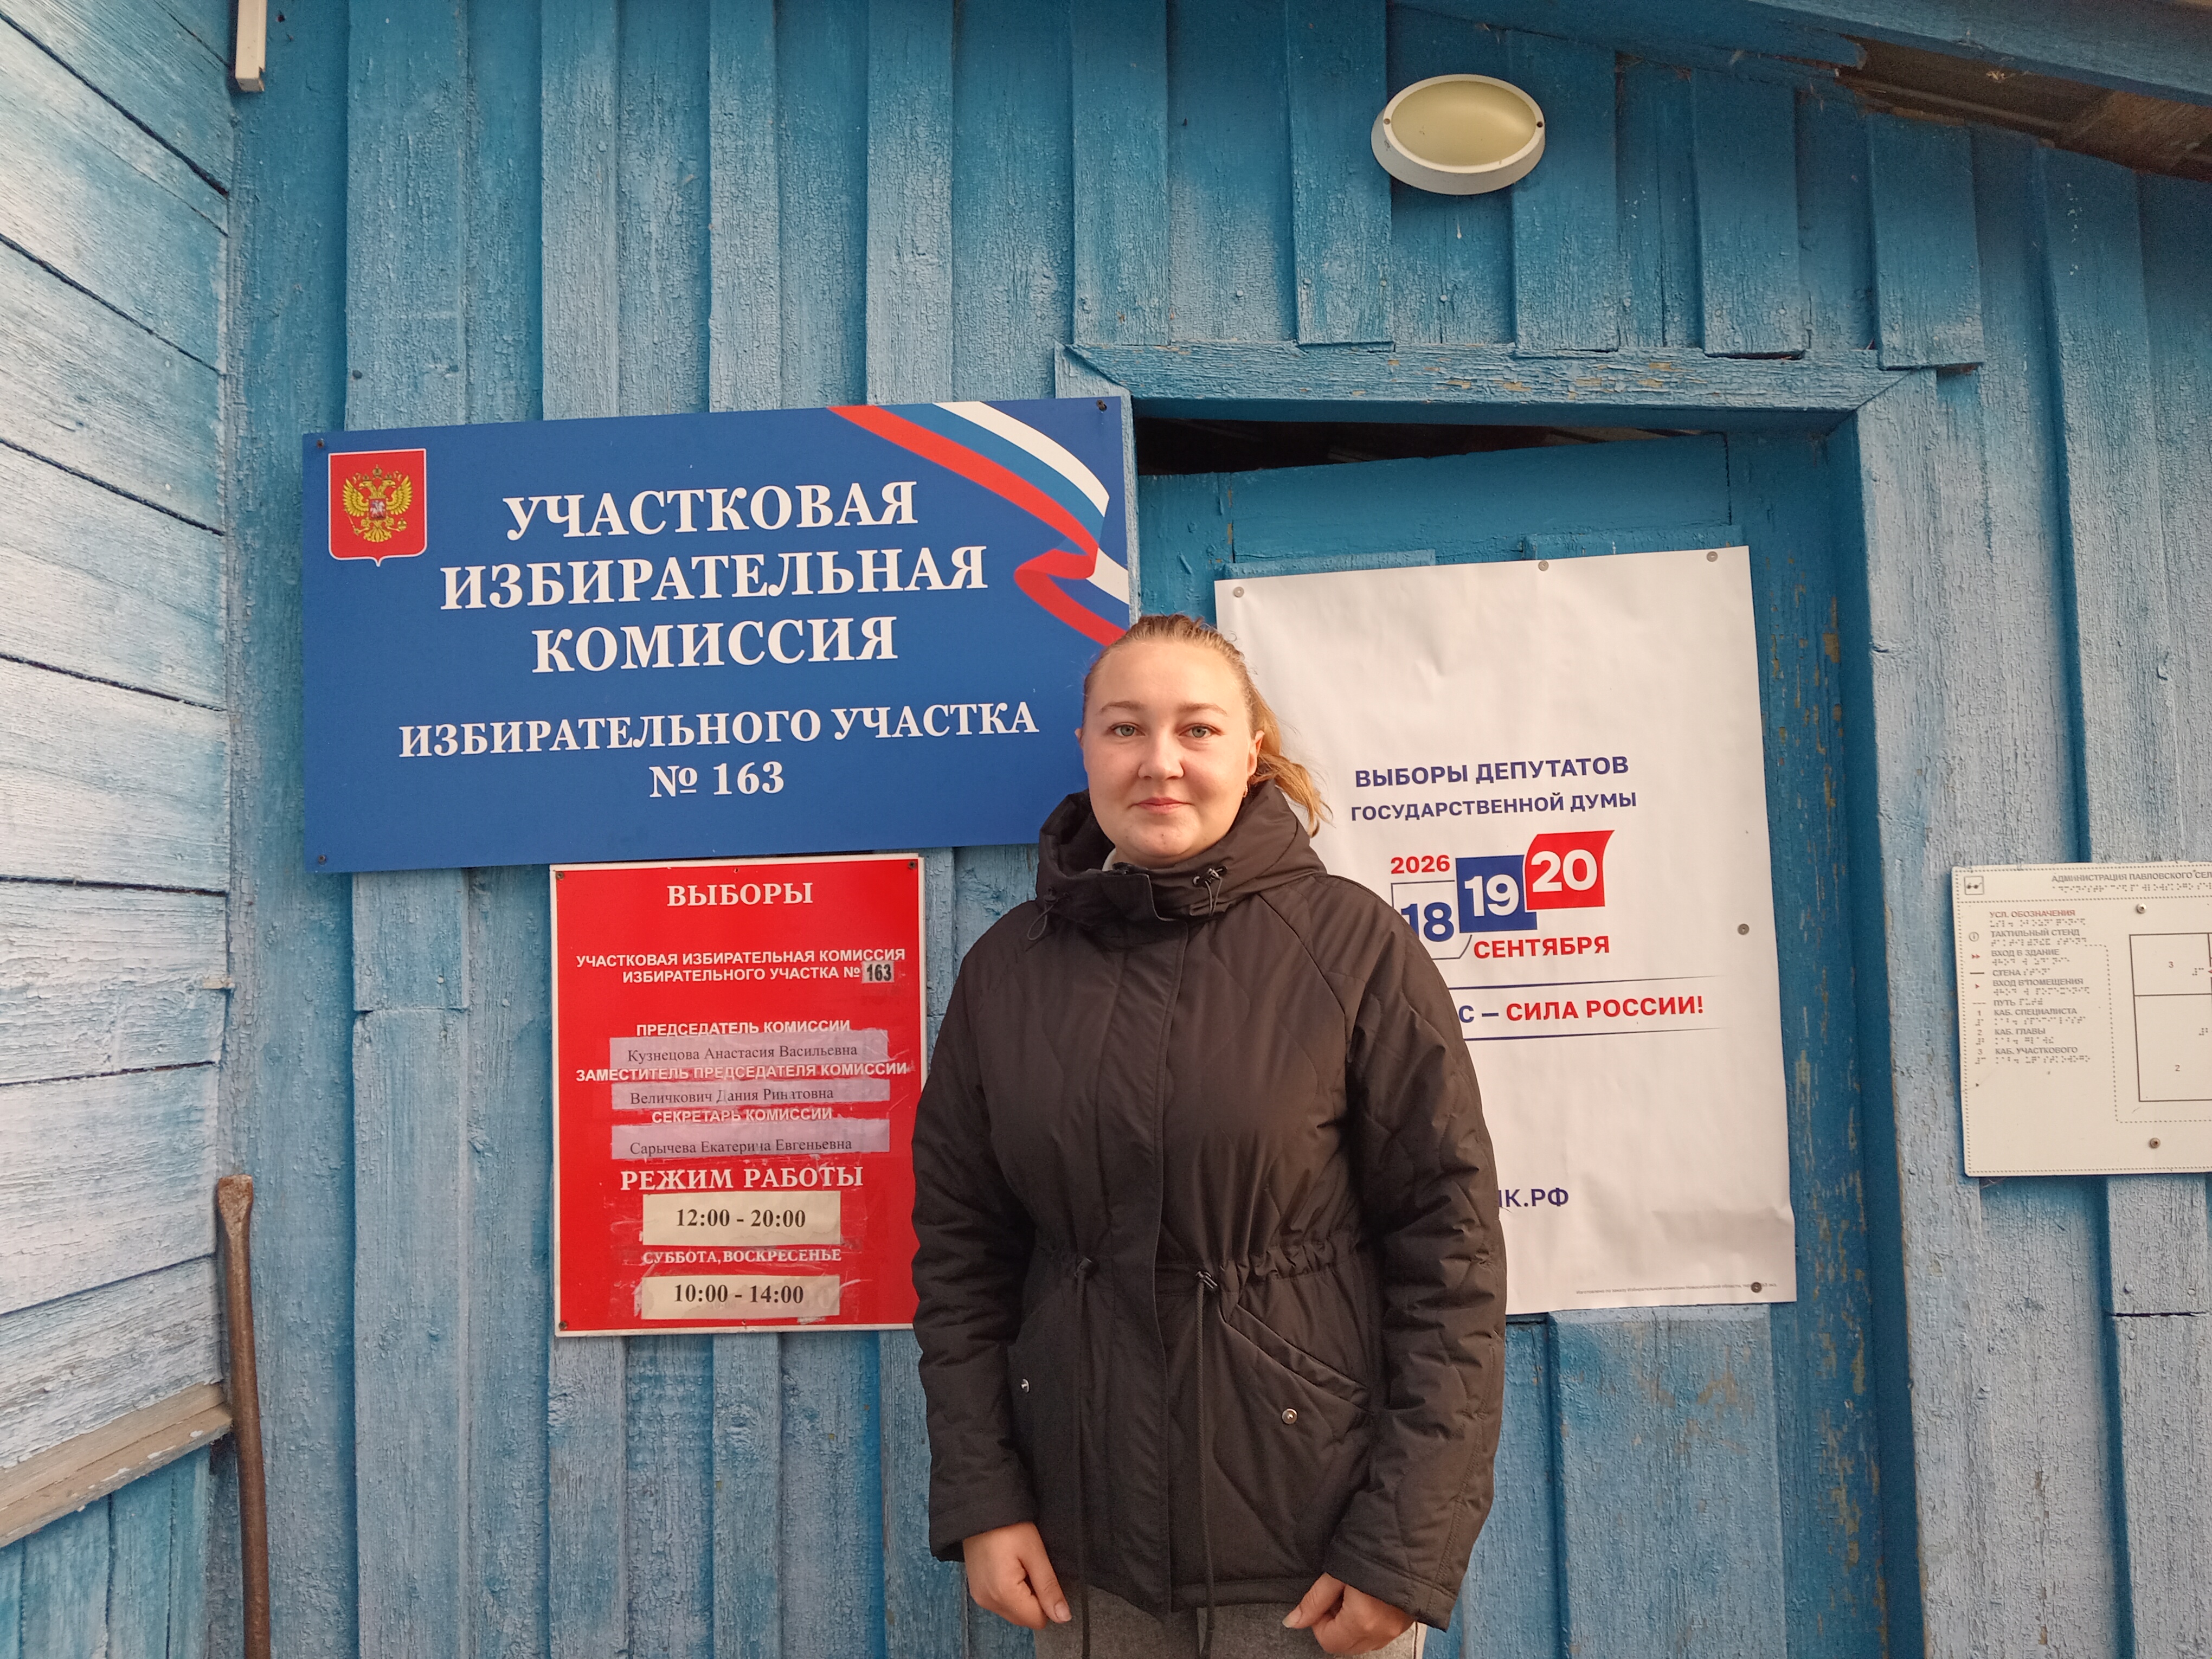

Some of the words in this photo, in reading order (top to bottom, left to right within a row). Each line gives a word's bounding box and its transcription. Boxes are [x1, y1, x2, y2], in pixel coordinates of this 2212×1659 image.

[503, 481, 918, 540] УЧАСТКОВАЯ
[440, 546, 988, 609] ИЗБИРАТЕЛЬНАЯ
[532, 617, 898, 672] КОМИССИЯ
[399, 710, 820, 757] ИЗБИРАТЕЛЬНОГО
[831, 702, 1039, 740] УЧАСТКА
[649, 766, 697, 797] №
[713, 762, 783, 795] 163
[1356, 765, 1468, 787] ВЫБОРЫ
[1476, 756, 1628, 784] ДЕПУТАТОВ
[1352, 796, 1564, 821] ГОСУДАРСТВЕННОЙ
[1571, 793, 1636, 812] ДУМЫ
[1391, 855, 1450, 874] 2026
[2052, 874, 2127, 883] АДМИНИСТРАЦИЯ
[2129, 872, 2192, 880] ПАВЛОВСКОГО
[667, 883, 813, 906] ВЫБОРЫ
[1401, 902, 1454, 942] 18
[1465, 874, 1519, 916] 19
[1532, 850, 1597, 892] 20
[1991, 928, 2049, 937] ТАКТИЛЬНЫЙ
[1474, 936, 1609, 959] СЕНТЯБРЯ
[576, 954, 677, 967] УЧАСТКОВАЯ
[683, 950, 814, 964] ИЗБИРАТЕЛЬНАЯ
[820, 949, 904, 962] КОМИССИЯ
[623, 968, 765, 983] ИЗБИРАТЕЛЬНОГО
[770, 967, 839, 979] УЧАСТКА
[844, 967, 860, 978] №
[866, 963, 892, 982] 163
[1507, 1001, 1578, 1021] СИЛА
[1586, 996, 1702, 1018] РОССИИ!
[2015, 1008, 2077, 1016] СПЕЦИАЛИСТА
[636, 1023, 759, 1037] ПРЕДСЕДАТЕЛЬ
[763, 1019, 850, 1033] КОМИССИИ
[628, 1049, 700, 1063] Кузнецова
[704, 1047, 775, 1060] Анастасия
[780, 1045, 857, 1058] Васильевна
[576, 1068, 690, 1081] ЗАМЕСТИТЕЛЬ
[694, 1065, 815, 1079] ПРЕДСЕДАТЕЛЯ
[821, 1062, 907, 1075] КОМИССИИ
[630, 1091, 712, 1104] Величкович
[716, 1090, 758, 1103] Дания
[763, 1088, 834, 1099] Ринатовна
[652, 1110, 741, 1123] СЕКРЕТАРЬ
[745, 1108, 832, 1121] КОМИССИИ
[630, 1142, 697, 1158] Сарычева
[700, 1140, 770, 1154] Екатерина
[775, 1139, 852, 1152] Евгеньевна
[621, 1169, 734, 1191] РЕЖИМ
[744, 1166, 863, 1187] РАБОТЫ
[677, 1209, 729, 1226] 12:00
[751, 1210, 805, 1227] 20:00
[723, 1249, 841, 1262] ВОСКРЕСЕНЬЕ
[675, 1284, 728, 1302] 10:00
[751, 1285, 803, 1303] 14:00
